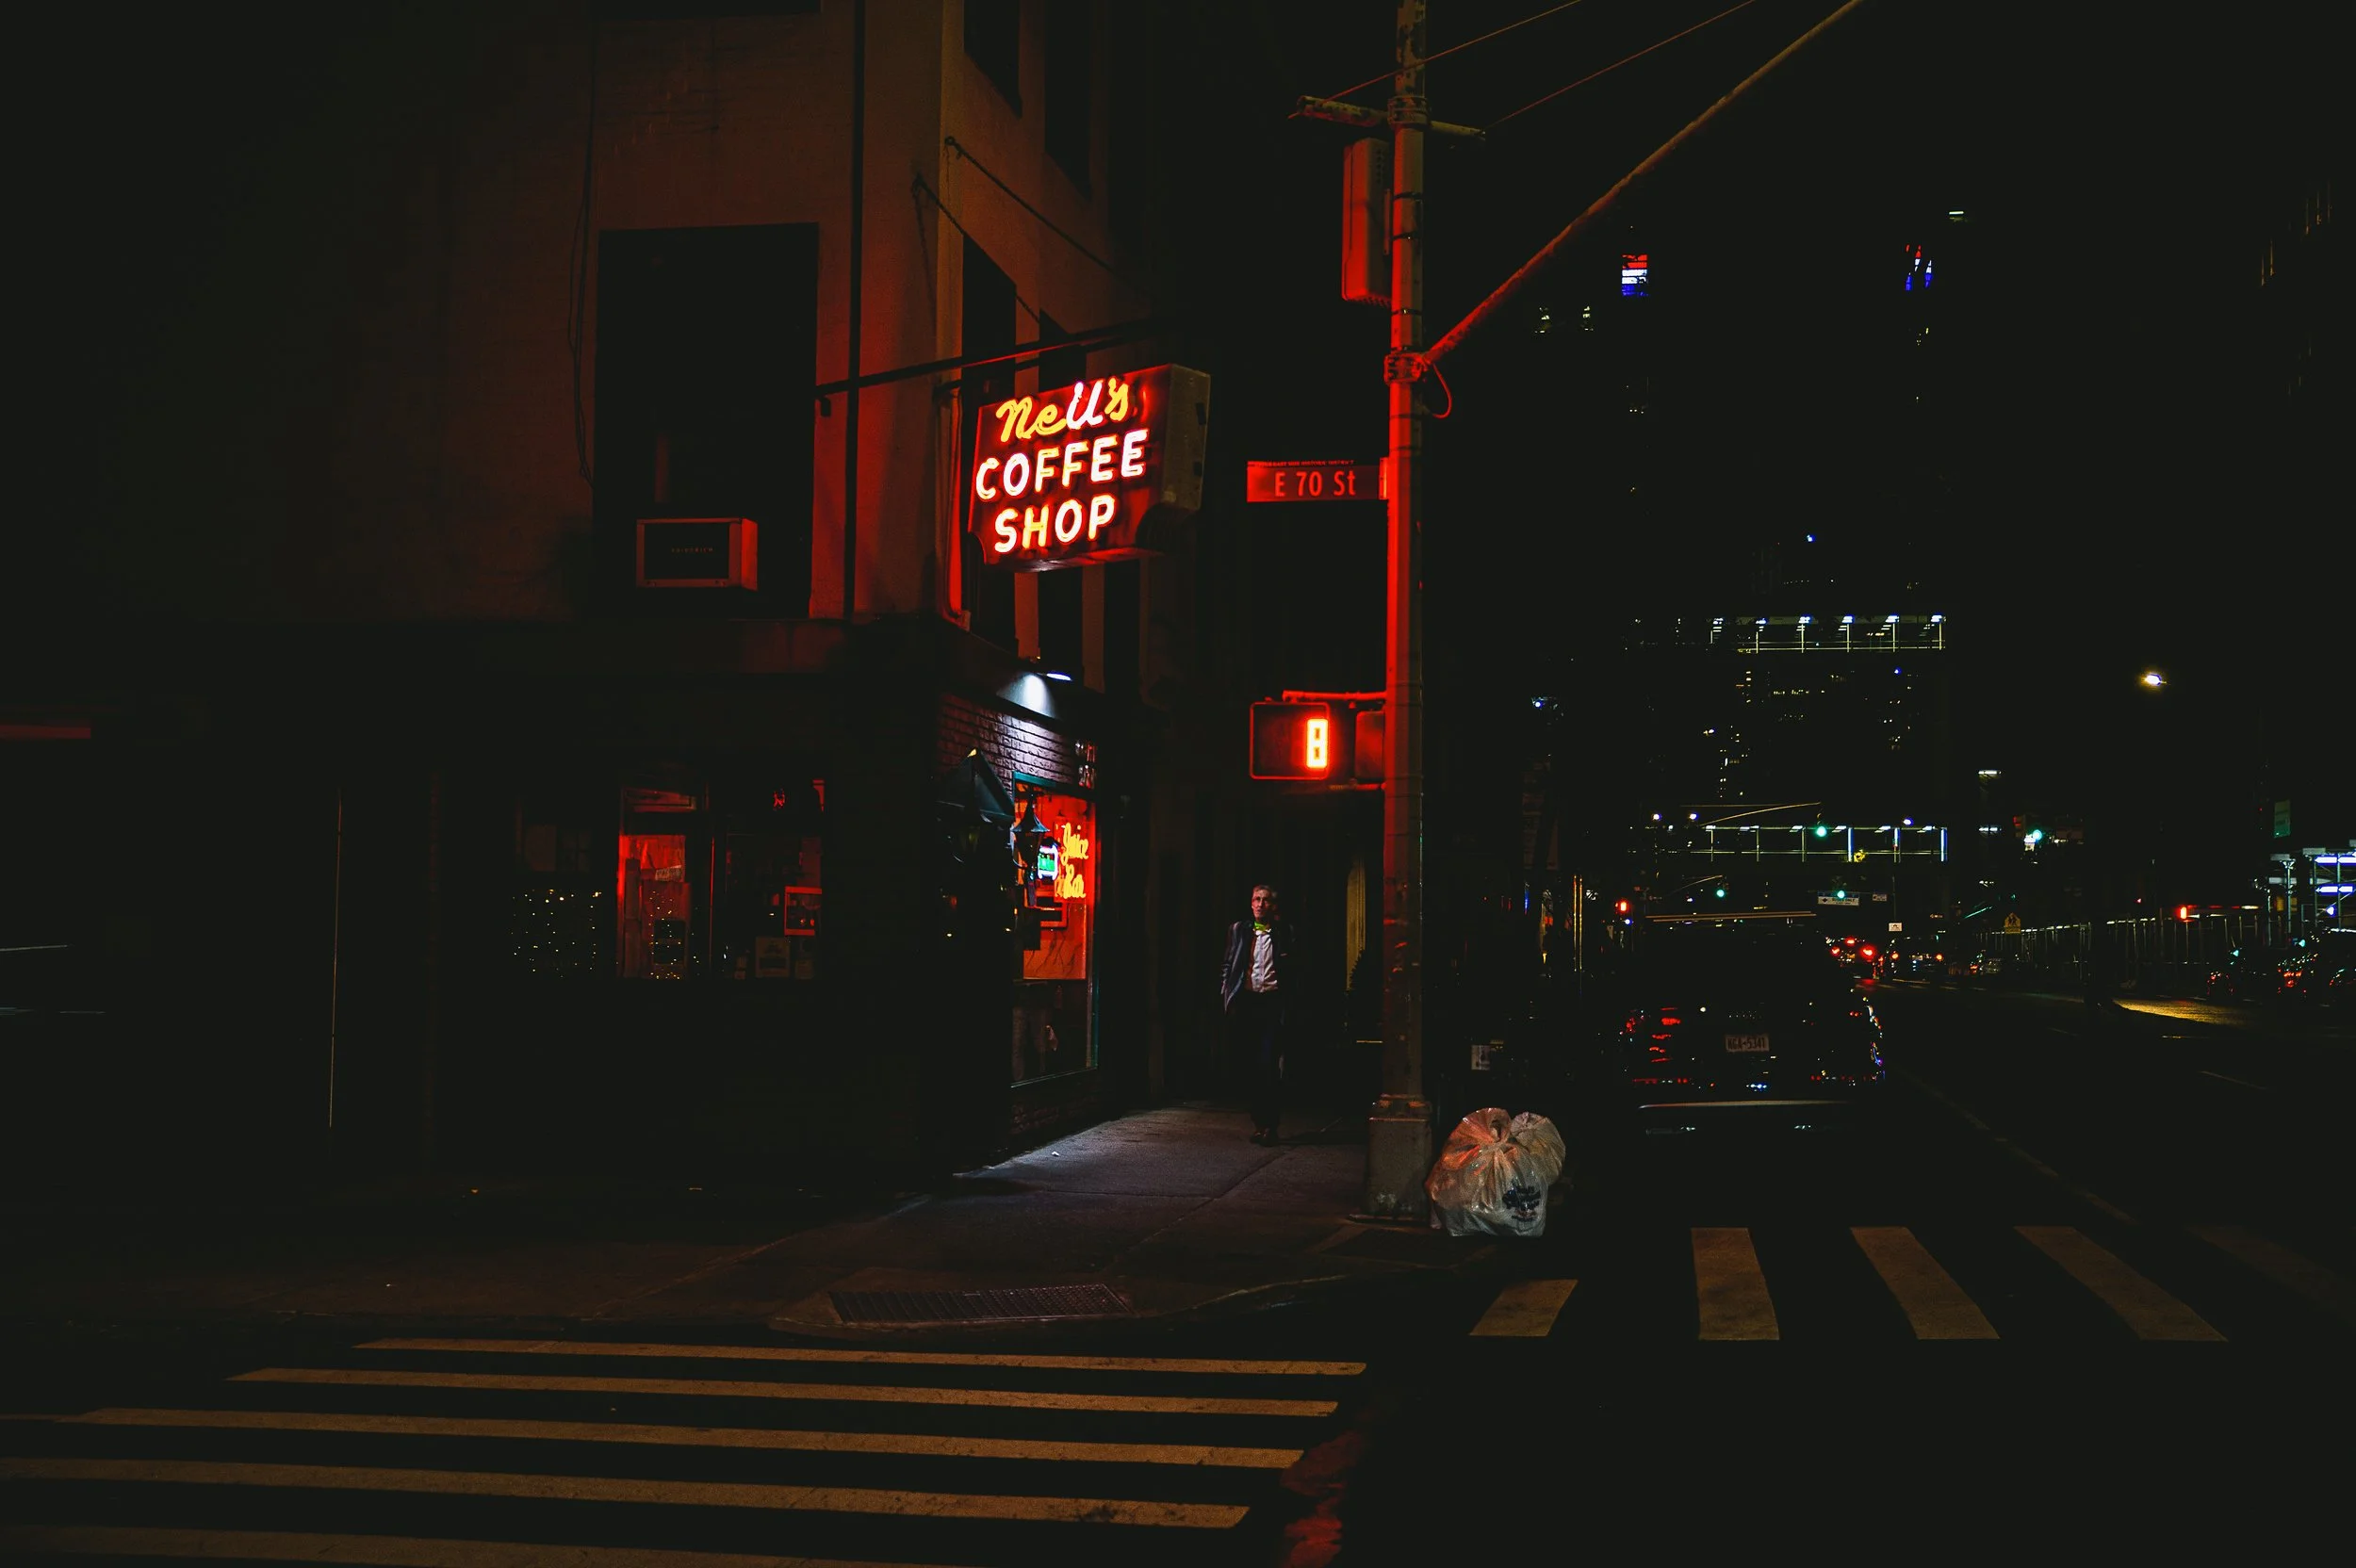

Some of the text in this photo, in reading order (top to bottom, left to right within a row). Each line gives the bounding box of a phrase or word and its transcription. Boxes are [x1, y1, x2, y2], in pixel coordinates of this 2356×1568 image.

[975, 428, 1150, 501] COFFEE
[1275, 470, 1356, 497] E 70 St
[994, 494, 1116, 553] SHOP
[1306, 718, 1329, 769] 8
